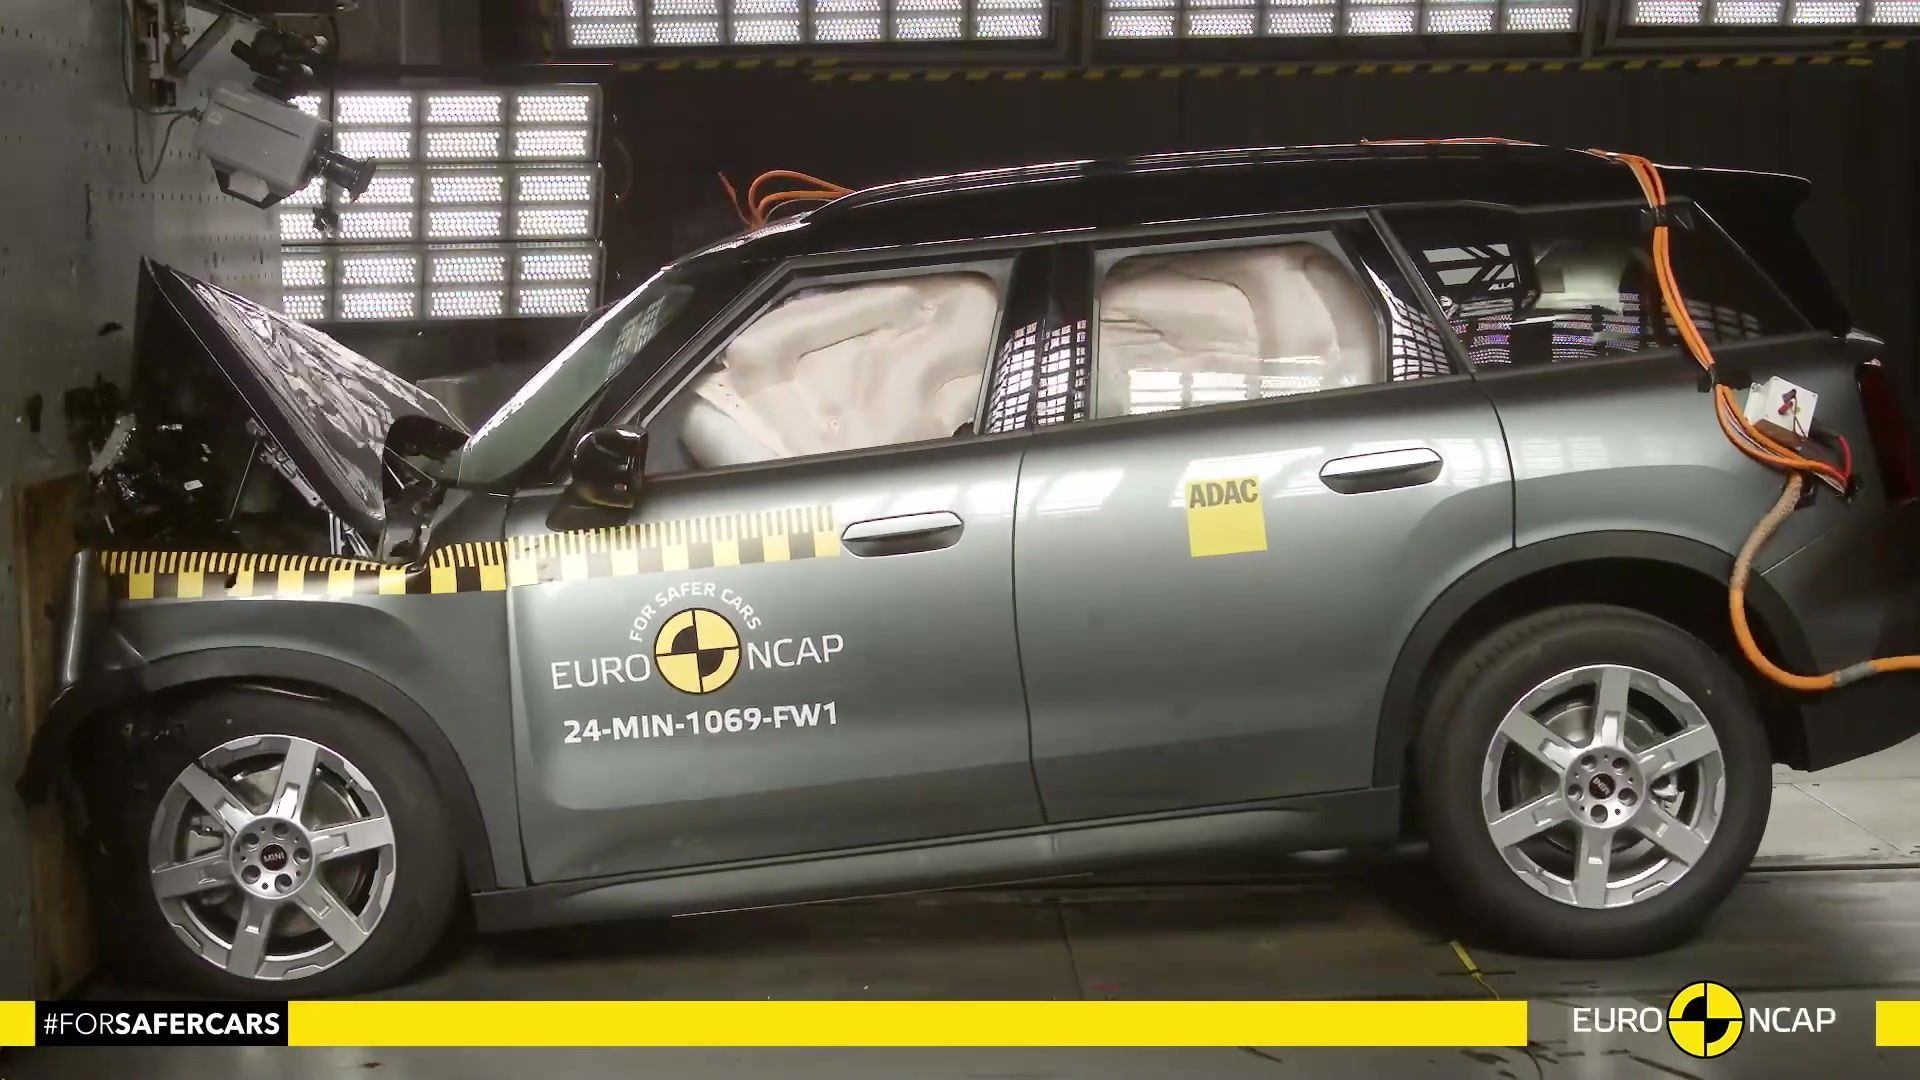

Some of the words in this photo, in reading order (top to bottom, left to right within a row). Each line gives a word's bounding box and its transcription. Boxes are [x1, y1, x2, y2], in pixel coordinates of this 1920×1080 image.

[1189, 478, 1258, 508] ADAC
[629, 604, 657, 642] FOR
[655, 582, 716, 608] SAFER
[720, 588, 762, 630] CARS
[551, 653, 651, 690] EURO
[747, 633, 844, 670] NCAP
[563, 701, 838, 744] 24-MIN-1069-FW1
[263, 852, 285, 863] MINI
